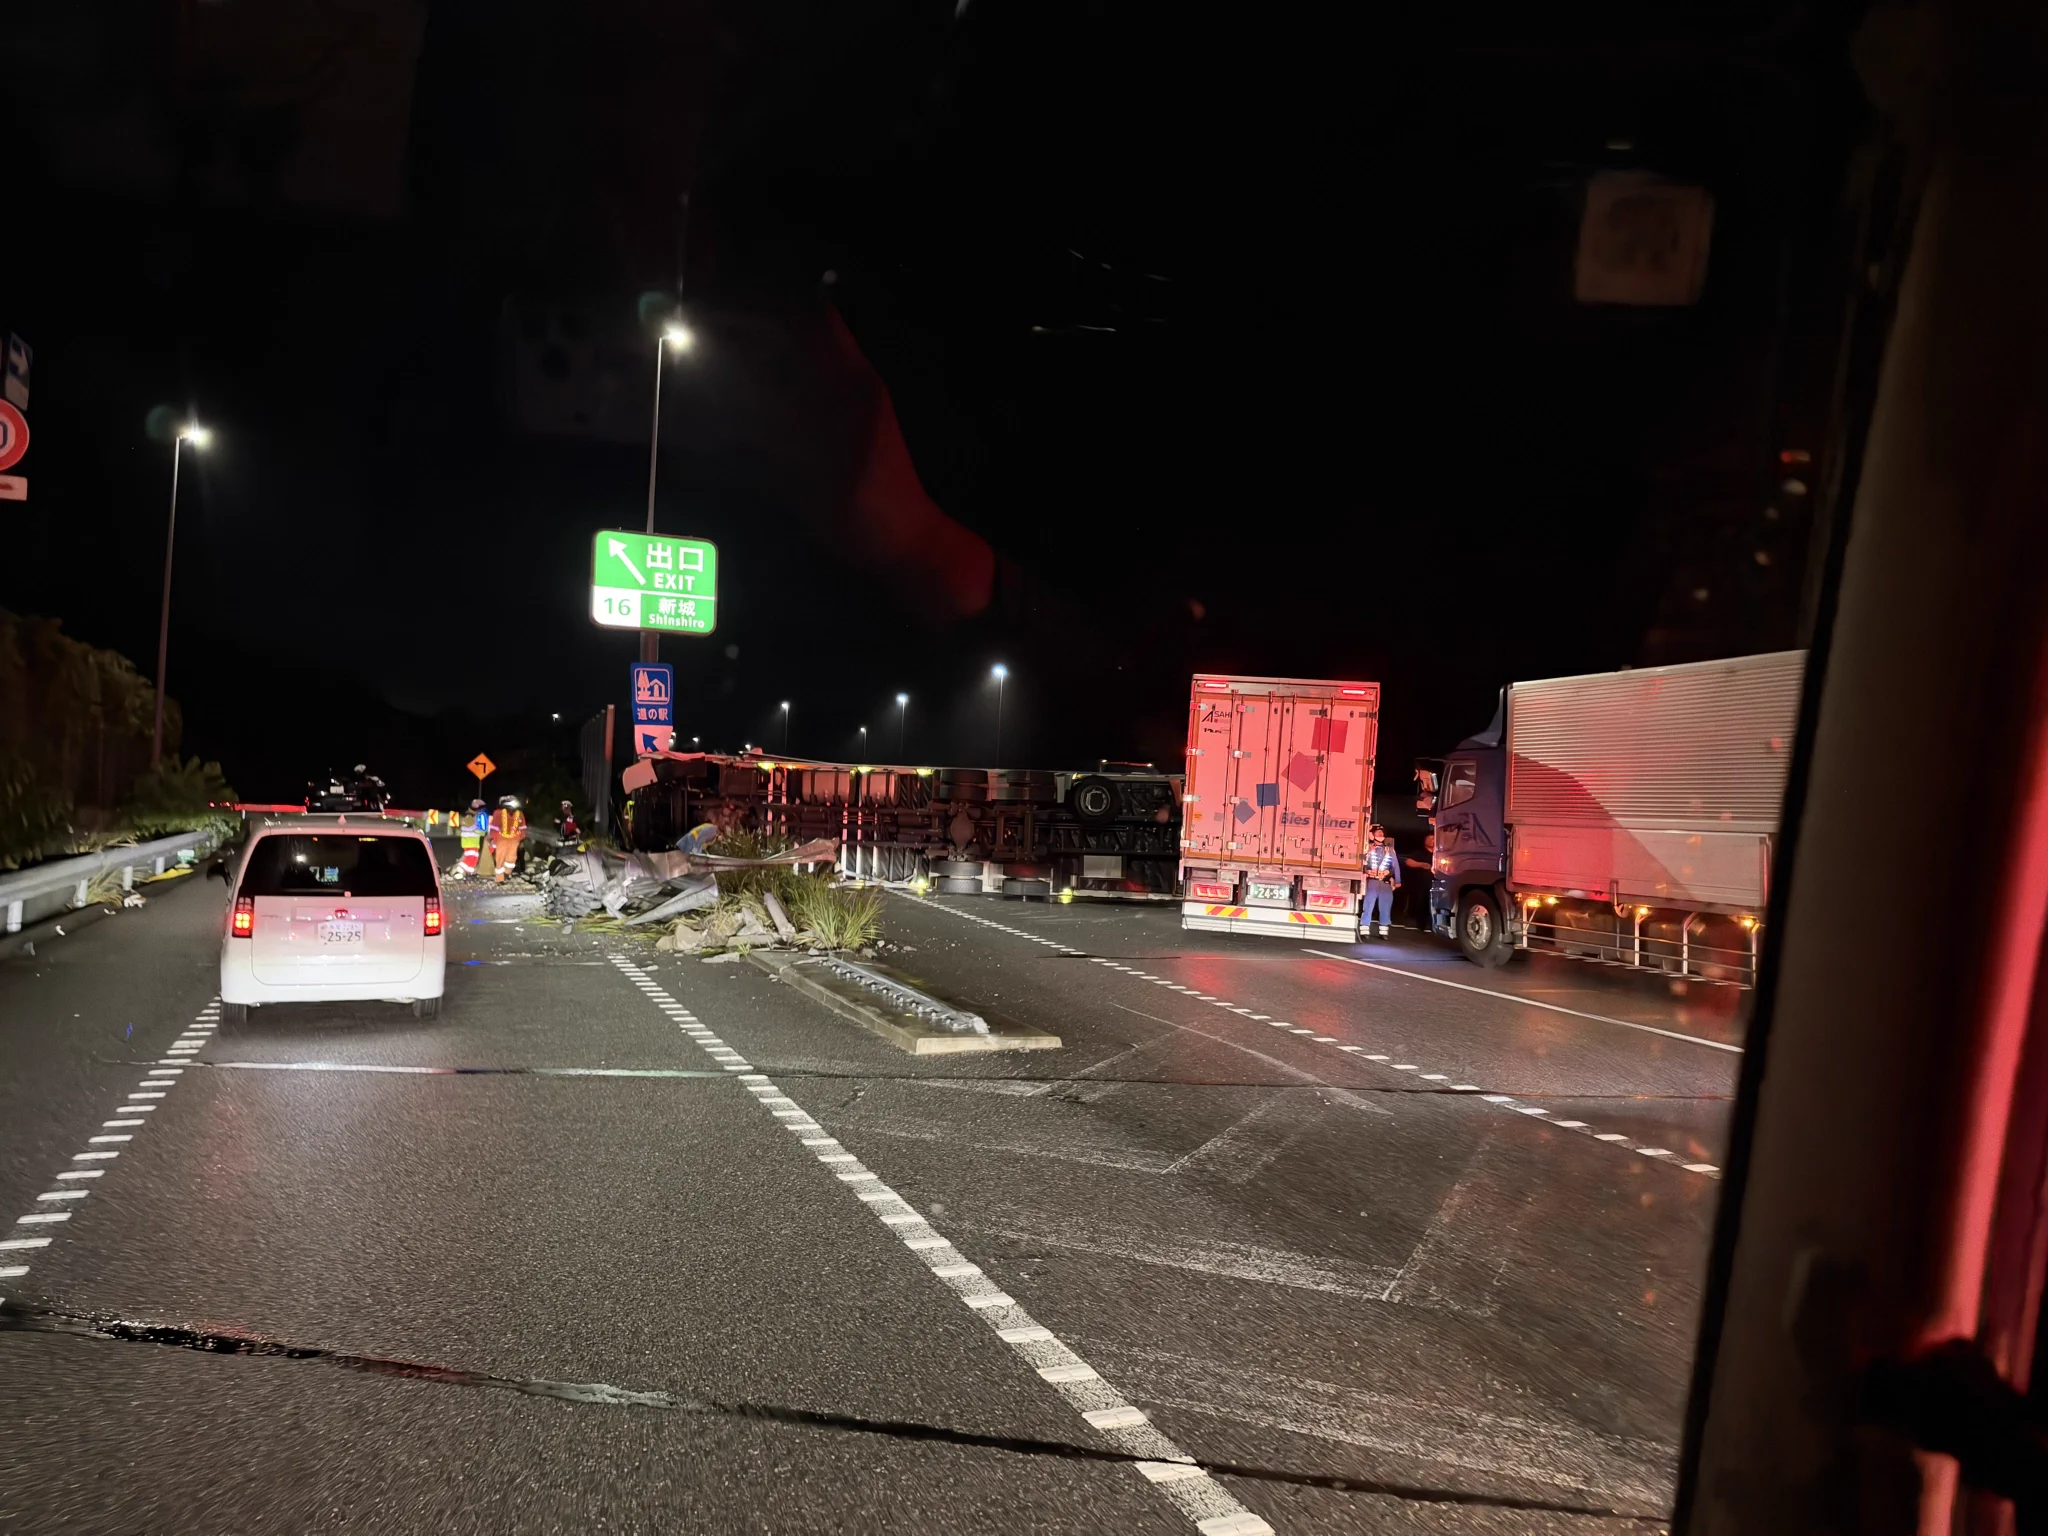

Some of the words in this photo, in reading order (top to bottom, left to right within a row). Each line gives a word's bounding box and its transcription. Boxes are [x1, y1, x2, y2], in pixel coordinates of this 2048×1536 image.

[646, 542, 704, 573] 出口
[654, 572, 695, 591] EXIT
[604, 597, 631, 616] 16
[659, 598, 696, 617] 新城
[649, 613, 705, 628] Shinshiro
[637, 707, 669, 721] 道の駅
